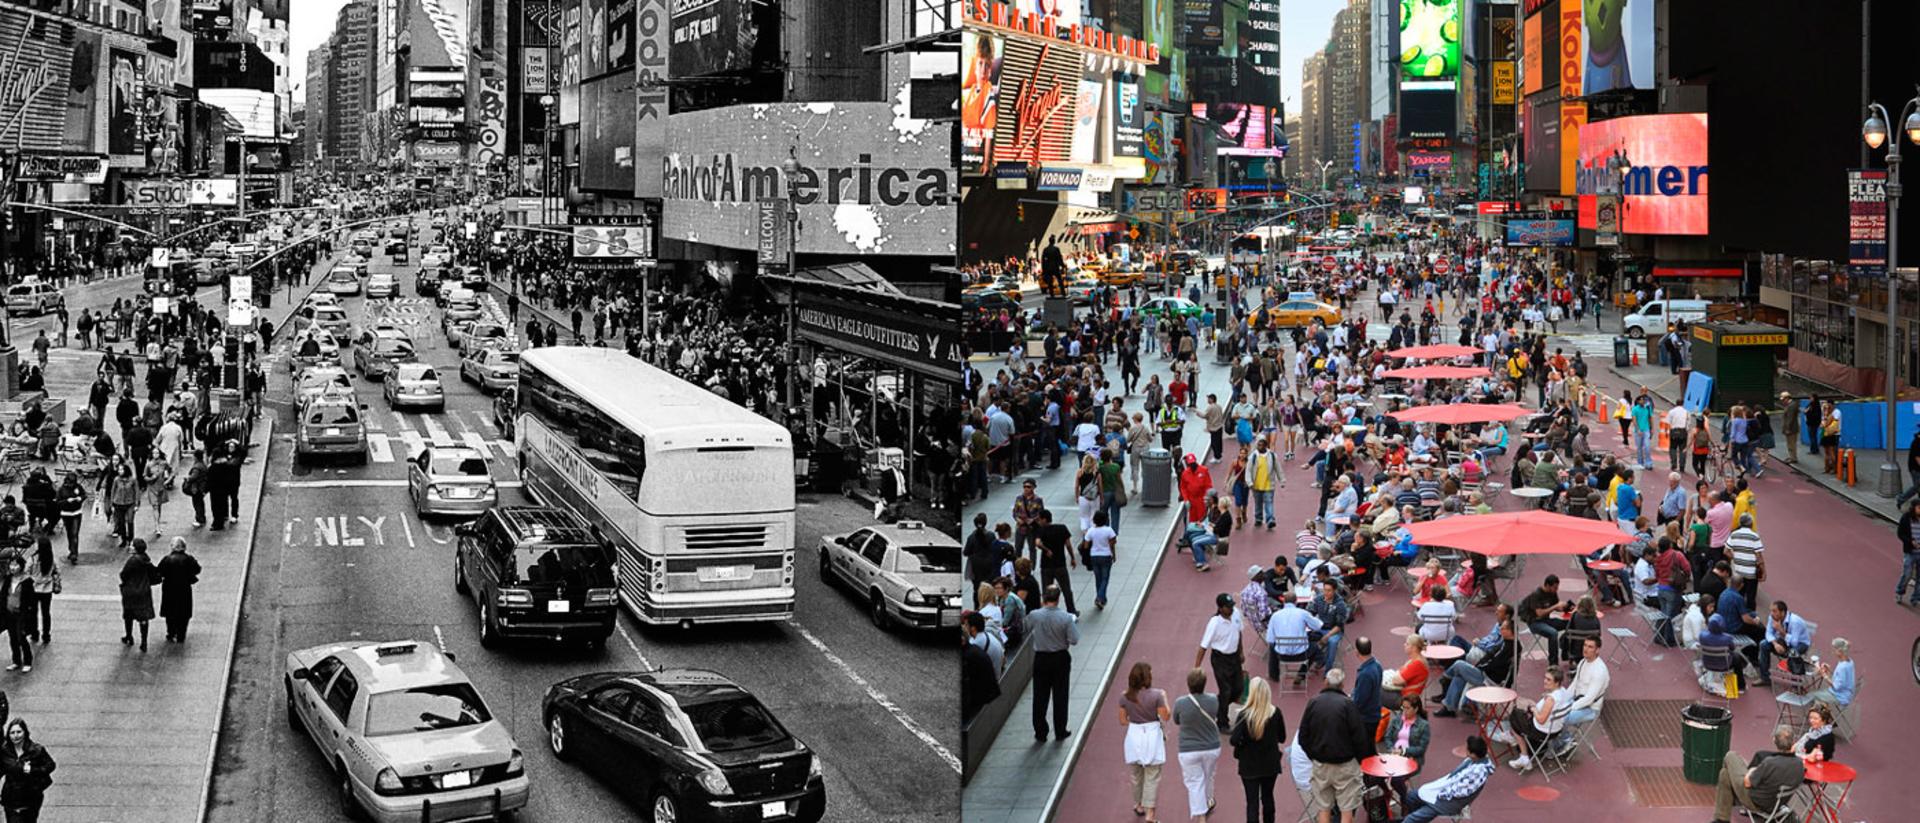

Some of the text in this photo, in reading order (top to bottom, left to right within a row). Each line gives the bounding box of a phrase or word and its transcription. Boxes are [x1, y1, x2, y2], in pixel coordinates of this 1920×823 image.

[1070, 23, 1160, 61] BUILDING
[526, 64, 545, 75] LION
[1563, 10, 1585, 130] Kodak
[526, 76, 545, 87] KING
[1495, 77, 1512, 87] LION
[1495, 88, 1513, 97] KING
[1409, 155, 1451, 166] YAHOO!
[662, 152, 949, 207] Bank of America
[1040, 172, 1081, 187] VORNADO
[1849, 184, 1886, 196] FLEA
[573, 217, 650, 225] MARQUI
[761, 201, 775, 262] WELCOME
[800, 308, 836, 331] AMERICAN
[837, 315, 863, 338] EAGLE
[863, 322, 920, 353] OUTFITTERS
[1724, 334, 1785, 345] NEWSSTAND
[579, 462, 599, 500] LINES
[285, 514, 387, 547] ONLY
